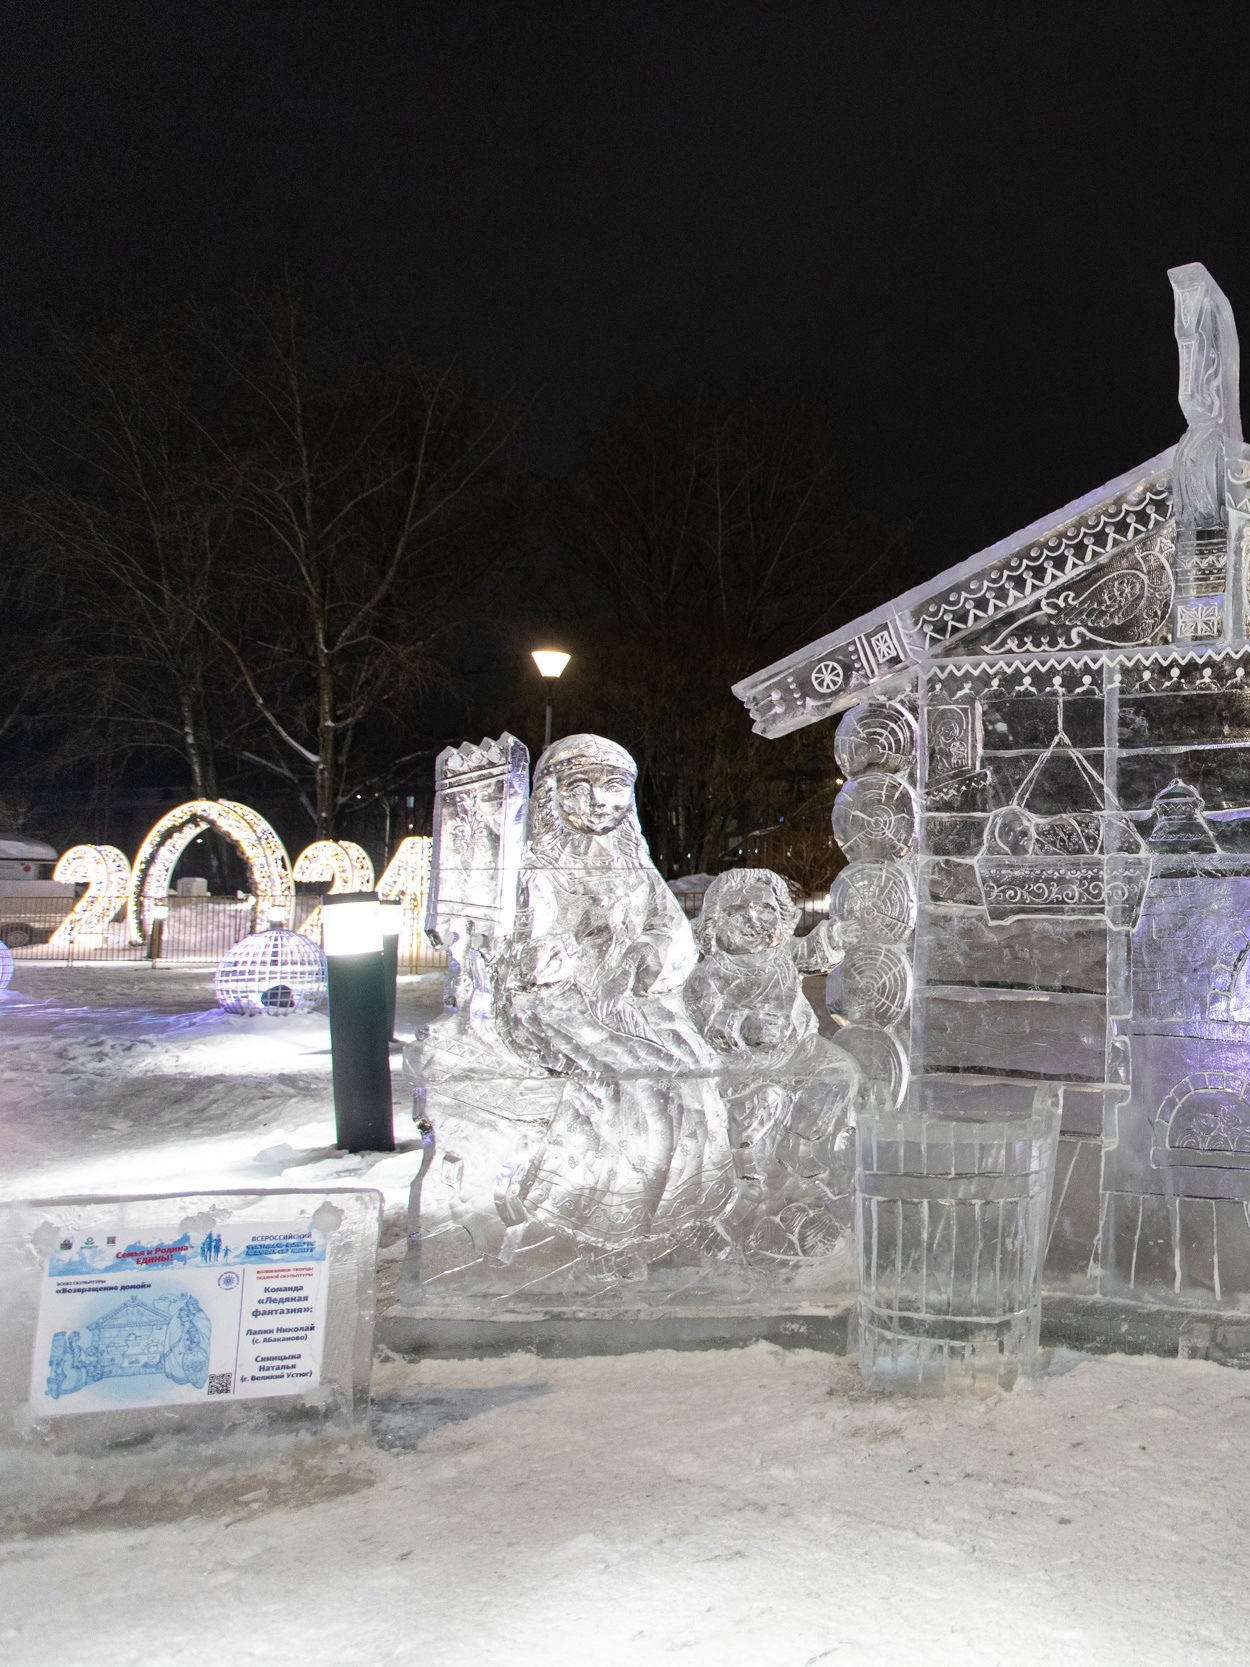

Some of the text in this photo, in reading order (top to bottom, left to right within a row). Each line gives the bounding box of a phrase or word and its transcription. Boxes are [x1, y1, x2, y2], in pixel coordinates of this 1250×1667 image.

[252, 1232, 312, 1241] ВСЕРОССИЙСКИЙ
[116, 1249, 144, 1259] Семья
[154, 1245, 188, 1256] Родина
[136, 1254, 173, 1265] ЕДИНЫ!
[56, 1282, 151, 1294] «Возвращение домой»
[264, 1286, 304, 1294] Команда
[257, 1295, 309, 1305] «Ледяная
[252, 1307, 313, 1318] фантазия»:
[245, 1324, 315, 1336] Лапин Николай
[252, 1334, 308, 1345] (с. Абаканово)
[255, 1353, 301, 1363] Синицына
[258, 1363, 296, 1372] Наталья
[240, 1370, 312, 1383] (г. Великий Устюг)
